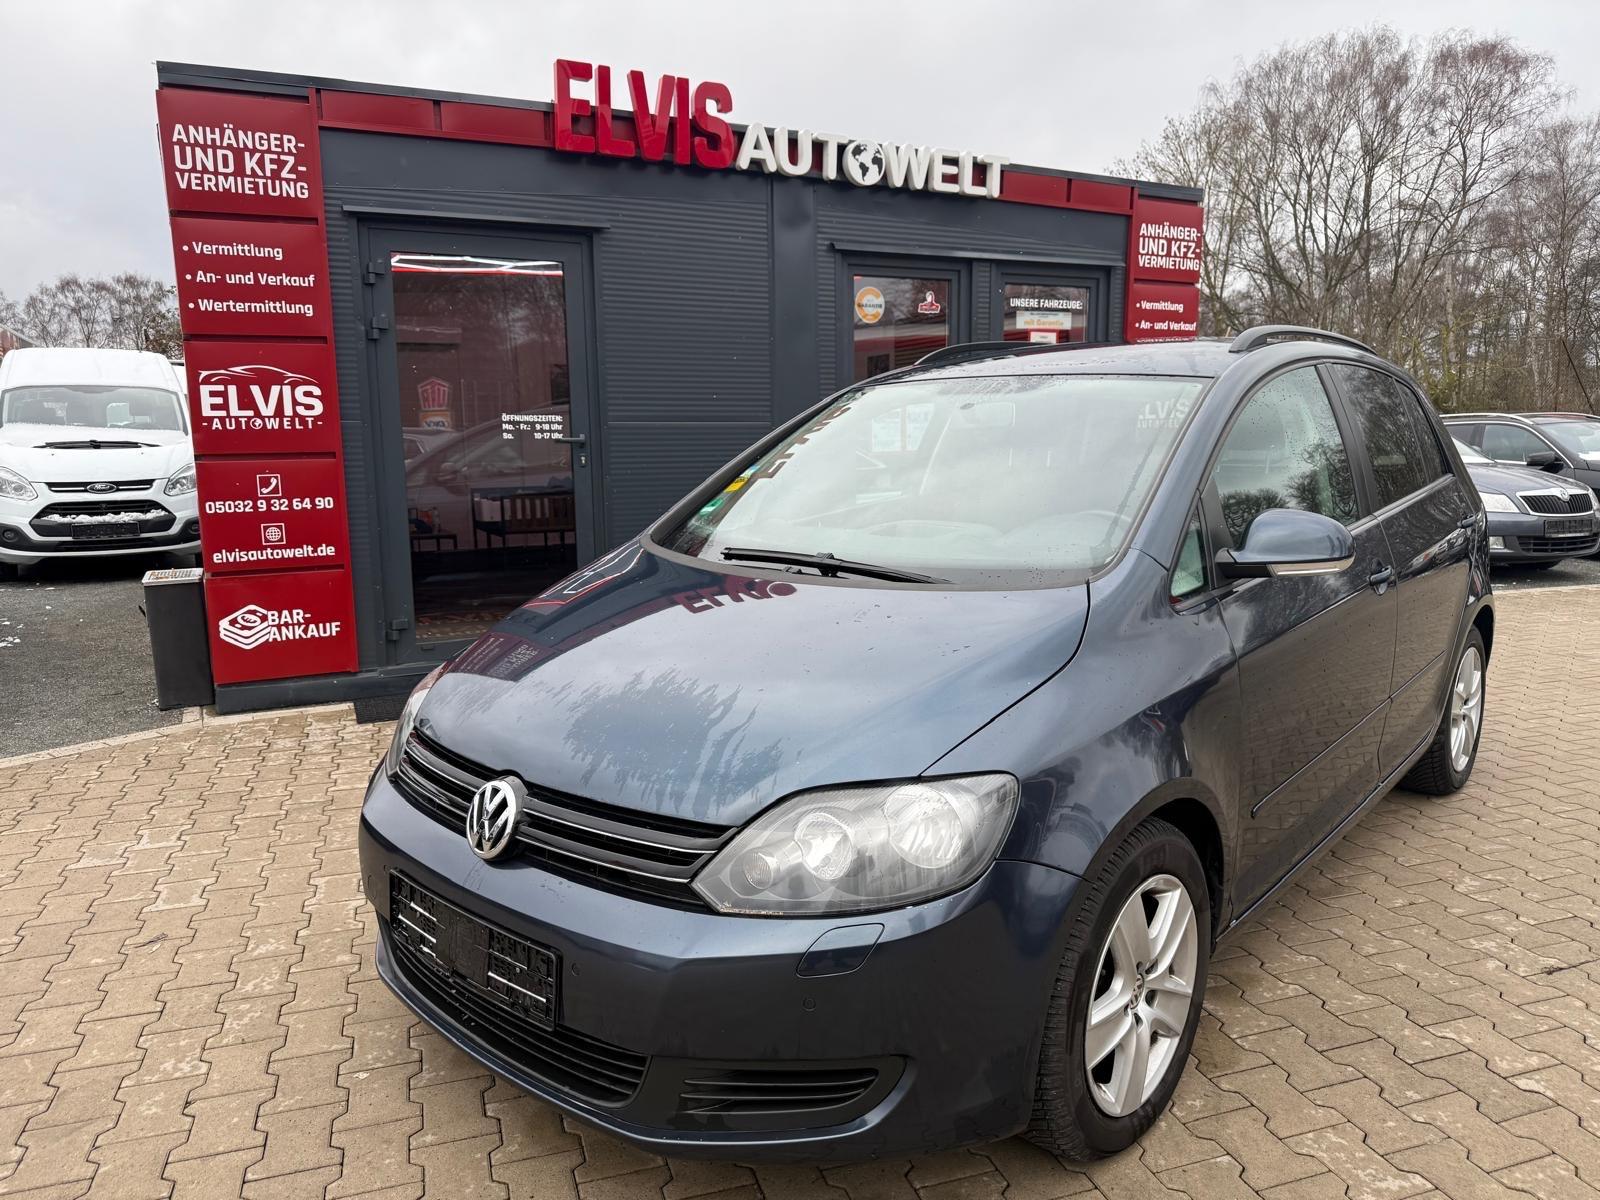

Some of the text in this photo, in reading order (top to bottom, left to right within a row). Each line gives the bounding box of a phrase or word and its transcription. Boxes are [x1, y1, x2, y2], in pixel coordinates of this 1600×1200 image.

[554, 58, 735, 168] ELVIS
[172, 123, 305, 153] ANHÄNGER-
[173, 144, 307, 179] UND KFZ-
[175, 171, 309, 198] VERMIETUNG
[1139, 221, 1201, 241] ANHÄNGER-
[192, 241, 283, 260] Vermittlung
[1139, 237, 1200, 258] UND KFZ-
[1138, 254, 1200, 270] VERMIETUNG
[196, 270, 315, 287] An- und Verkauf
[198, 298, 313, 317] Wertermittlung
[1010, 297, 1083, 310] UNSERE FAHRZEUGE:
[1141, 300, 1184, 313] Vermittlung
[1140, 319, 1197, 331] An- und Verkauf
[200, 384, 324, 417] ELVIS
[502, 413, 562, 421] ÖFFNUNGSZEITEN:
[551, 431, 563, 439] Uhr
[205, 497, 334, 513] 05032 9 32 64 90
[213, 544, 335, 563] elvisautowelt.de
[267, 609, 311, 625] BAR-
[268, 622, 341, 642] ANKAUF
